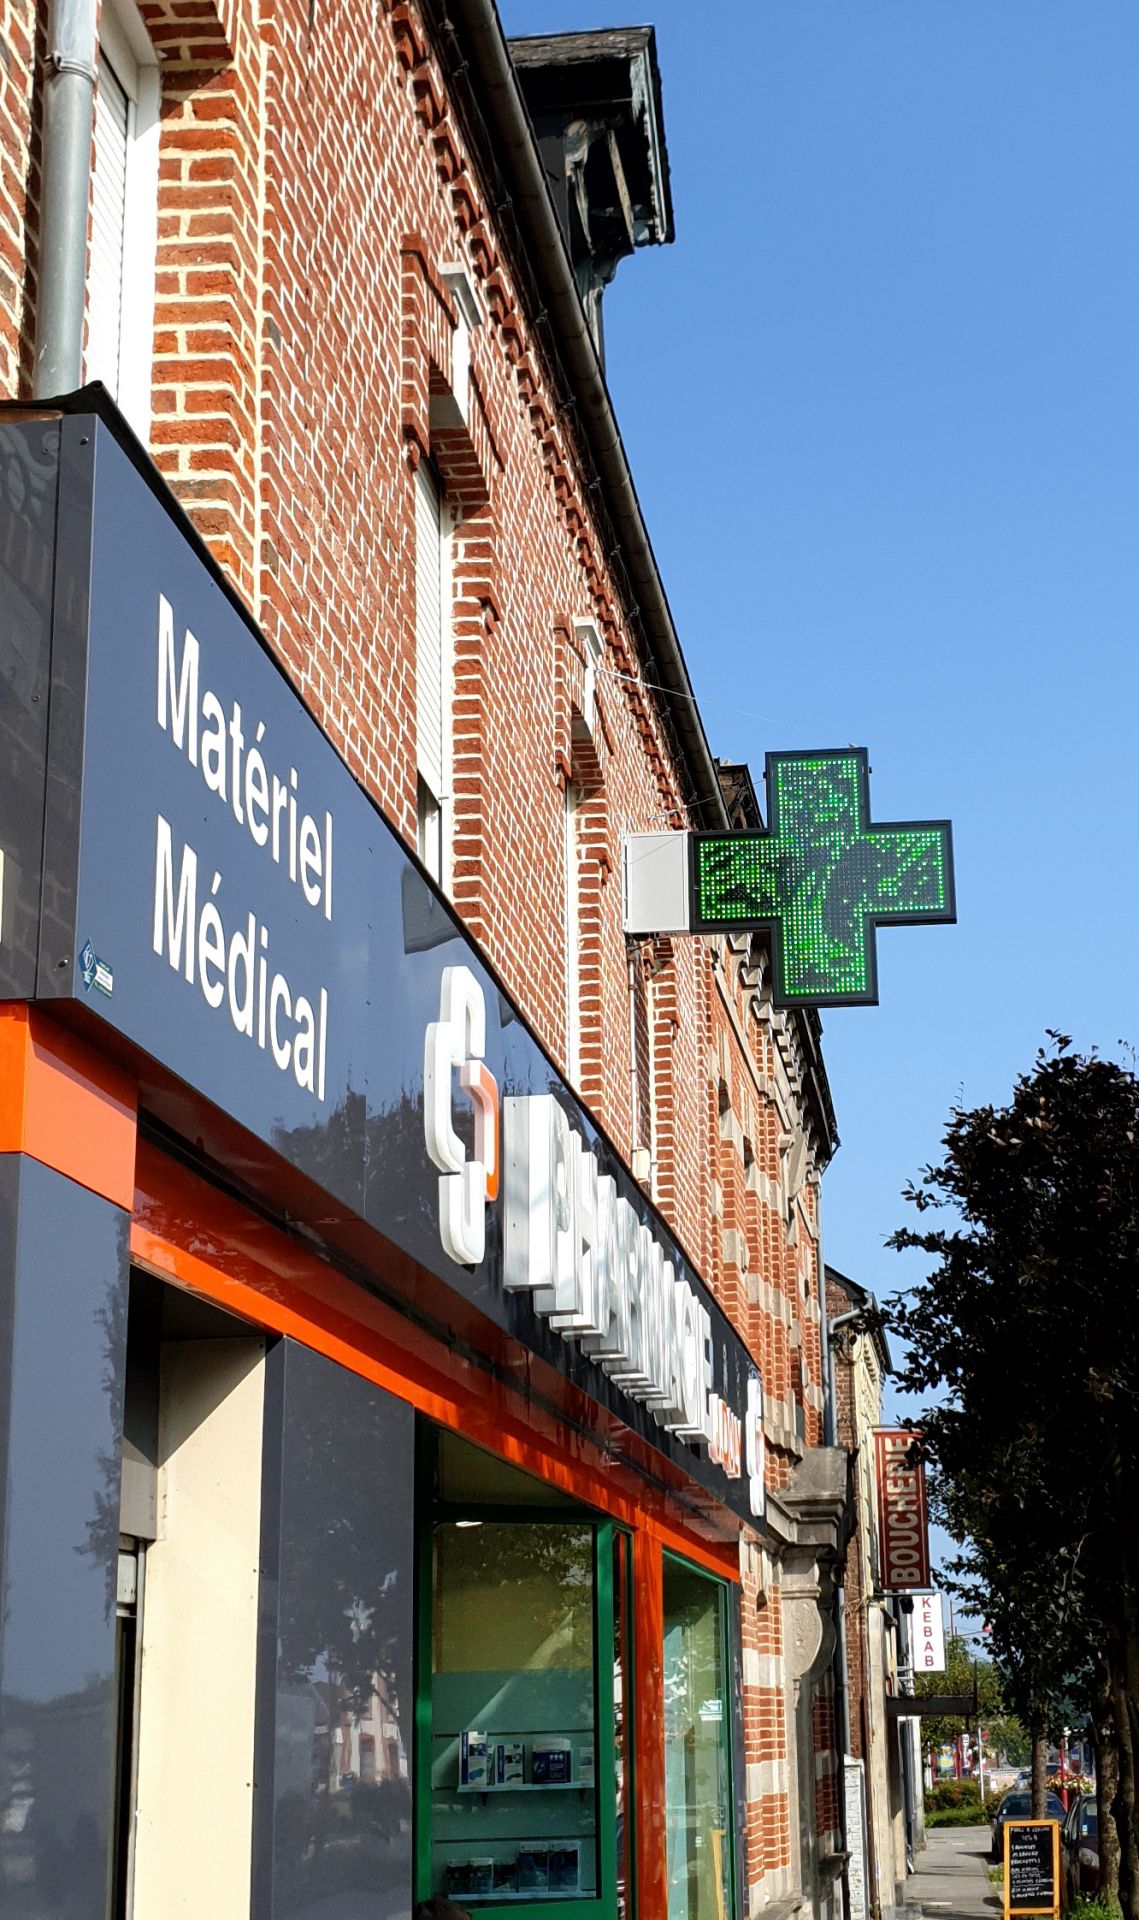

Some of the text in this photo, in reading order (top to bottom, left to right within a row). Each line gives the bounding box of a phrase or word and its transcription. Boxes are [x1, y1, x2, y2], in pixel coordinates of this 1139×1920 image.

[157, 593, 332, 921] Matériel
[153, 814, 327, 1102] Médical
[885, 1437, 921, 1584] BOUCHERIE
[921, 1597, 935, 1667] KEBAB
